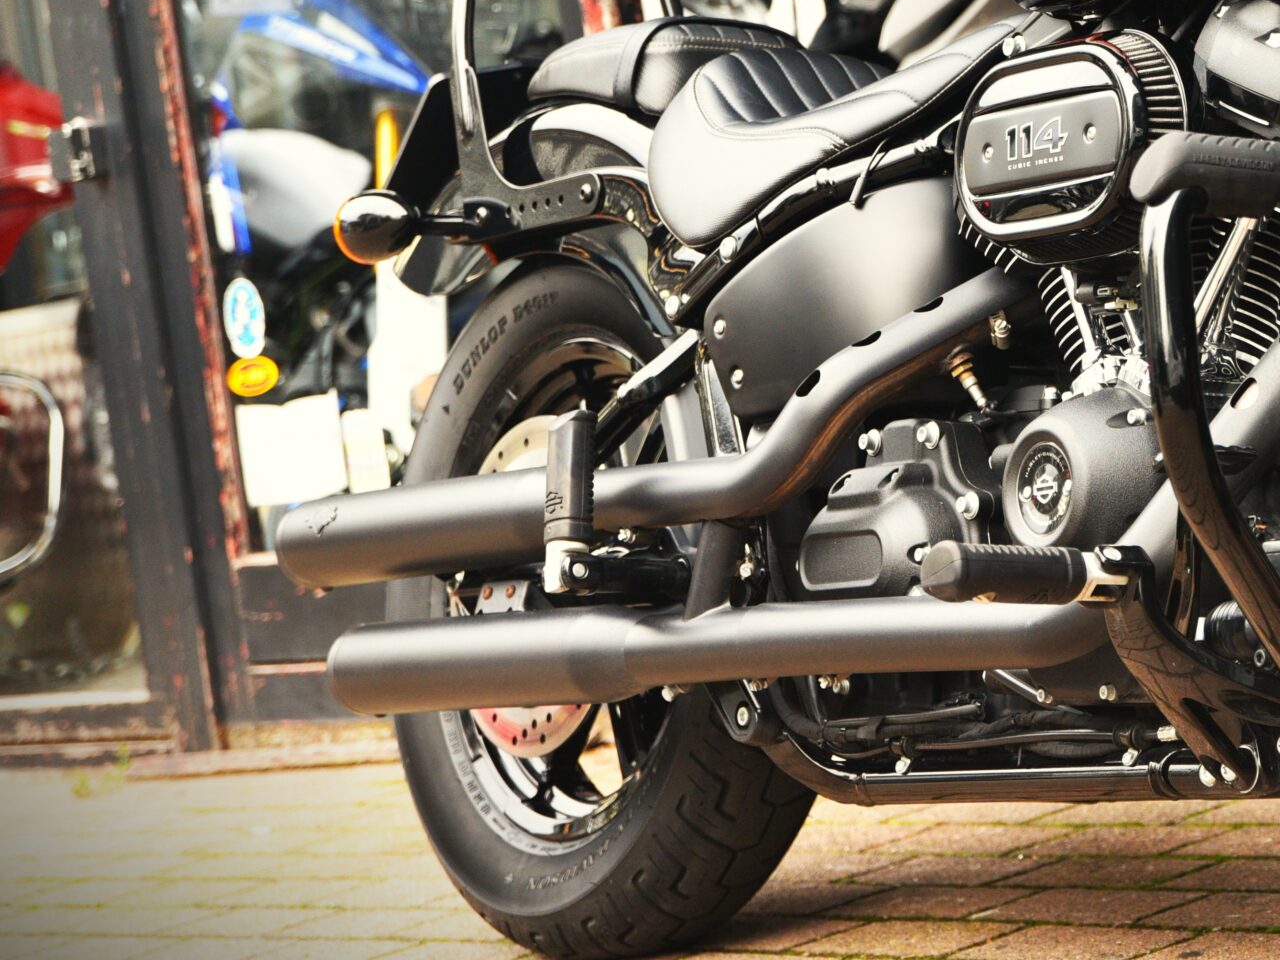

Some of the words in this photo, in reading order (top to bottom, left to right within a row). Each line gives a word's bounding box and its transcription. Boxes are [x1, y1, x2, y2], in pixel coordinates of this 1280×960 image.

[1005, 116, 1069, 161] 114
[1007, 161, 1031, 171] CUBIC
[1035, 155, 1064, 166] INCHES
[453, 315, 508, 396] DUNLOP
